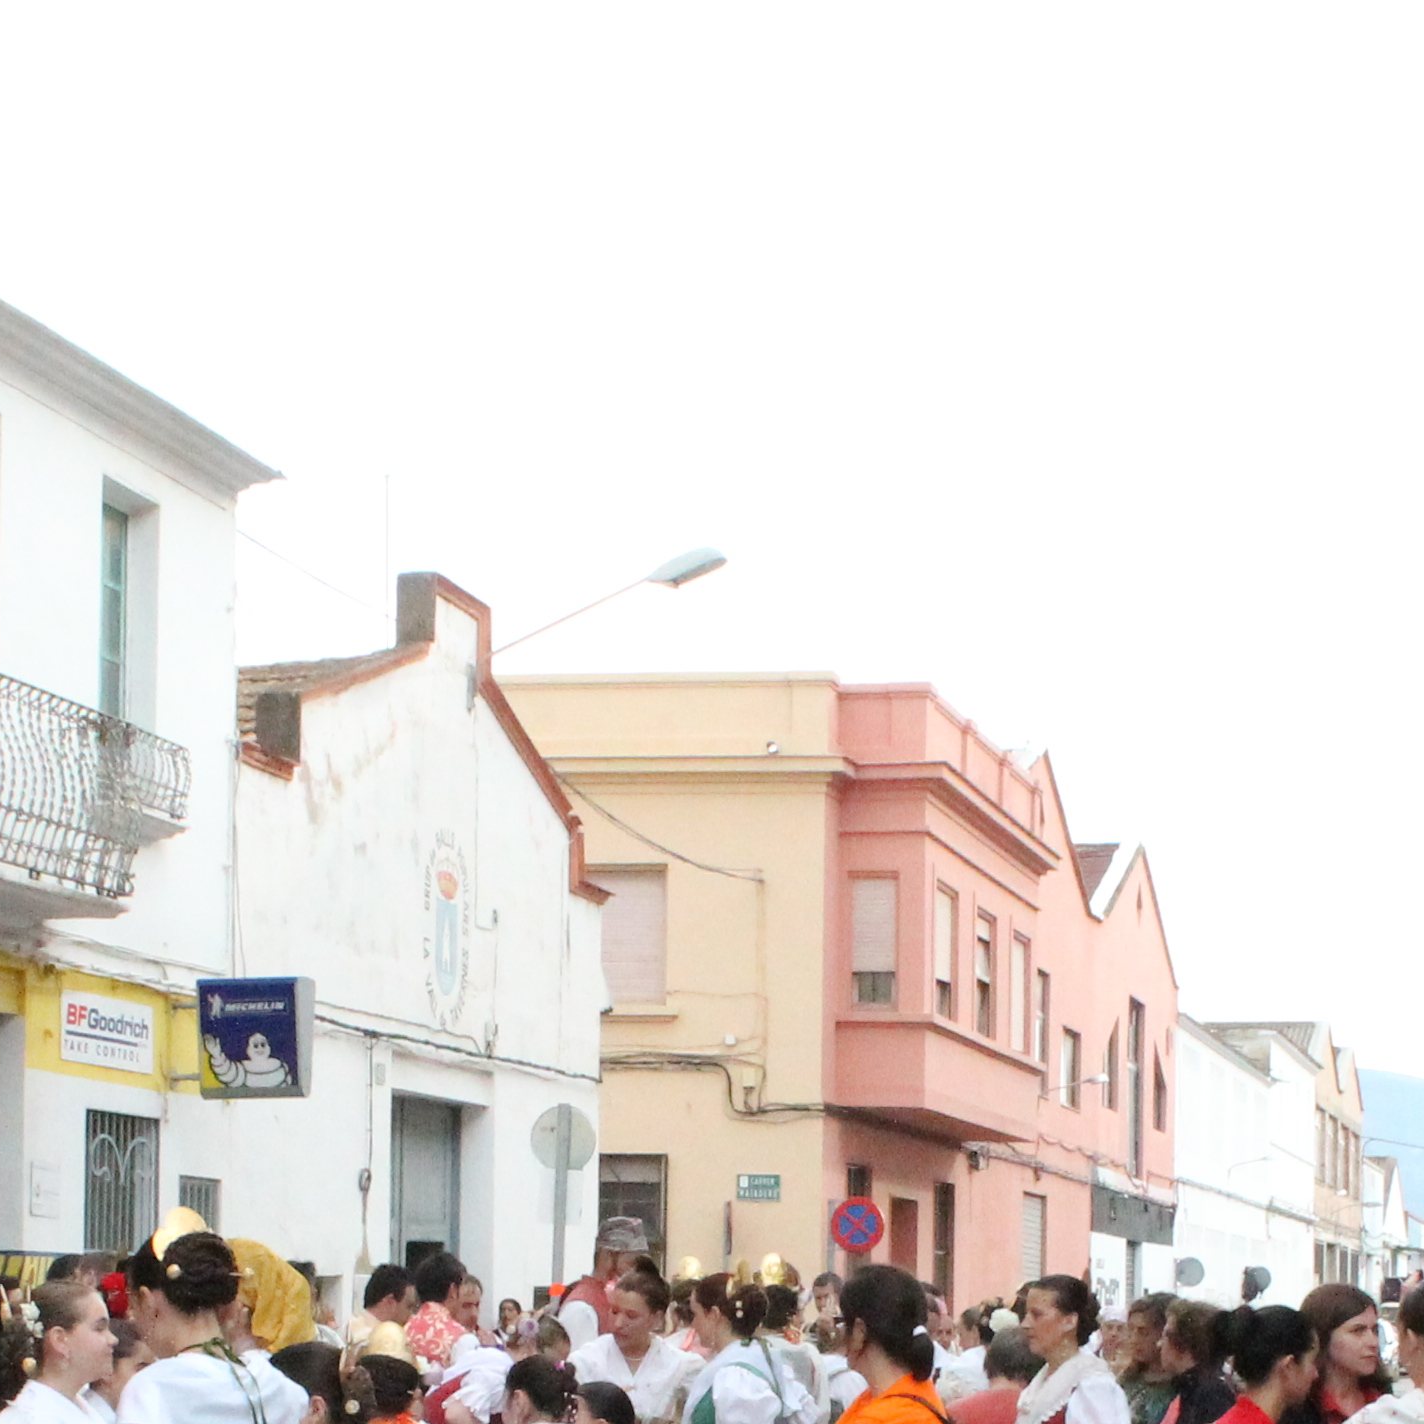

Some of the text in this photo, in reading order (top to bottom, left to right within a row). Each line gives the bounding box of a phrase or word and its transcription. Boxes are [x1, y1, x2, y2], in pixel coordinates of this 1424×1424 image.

[225, 1001, 285, 1012] MICHELIN
[66, 1003, 149, 1040] BFGoodrich
[64, 1039, 140, 1063] TAKE CONTROL
